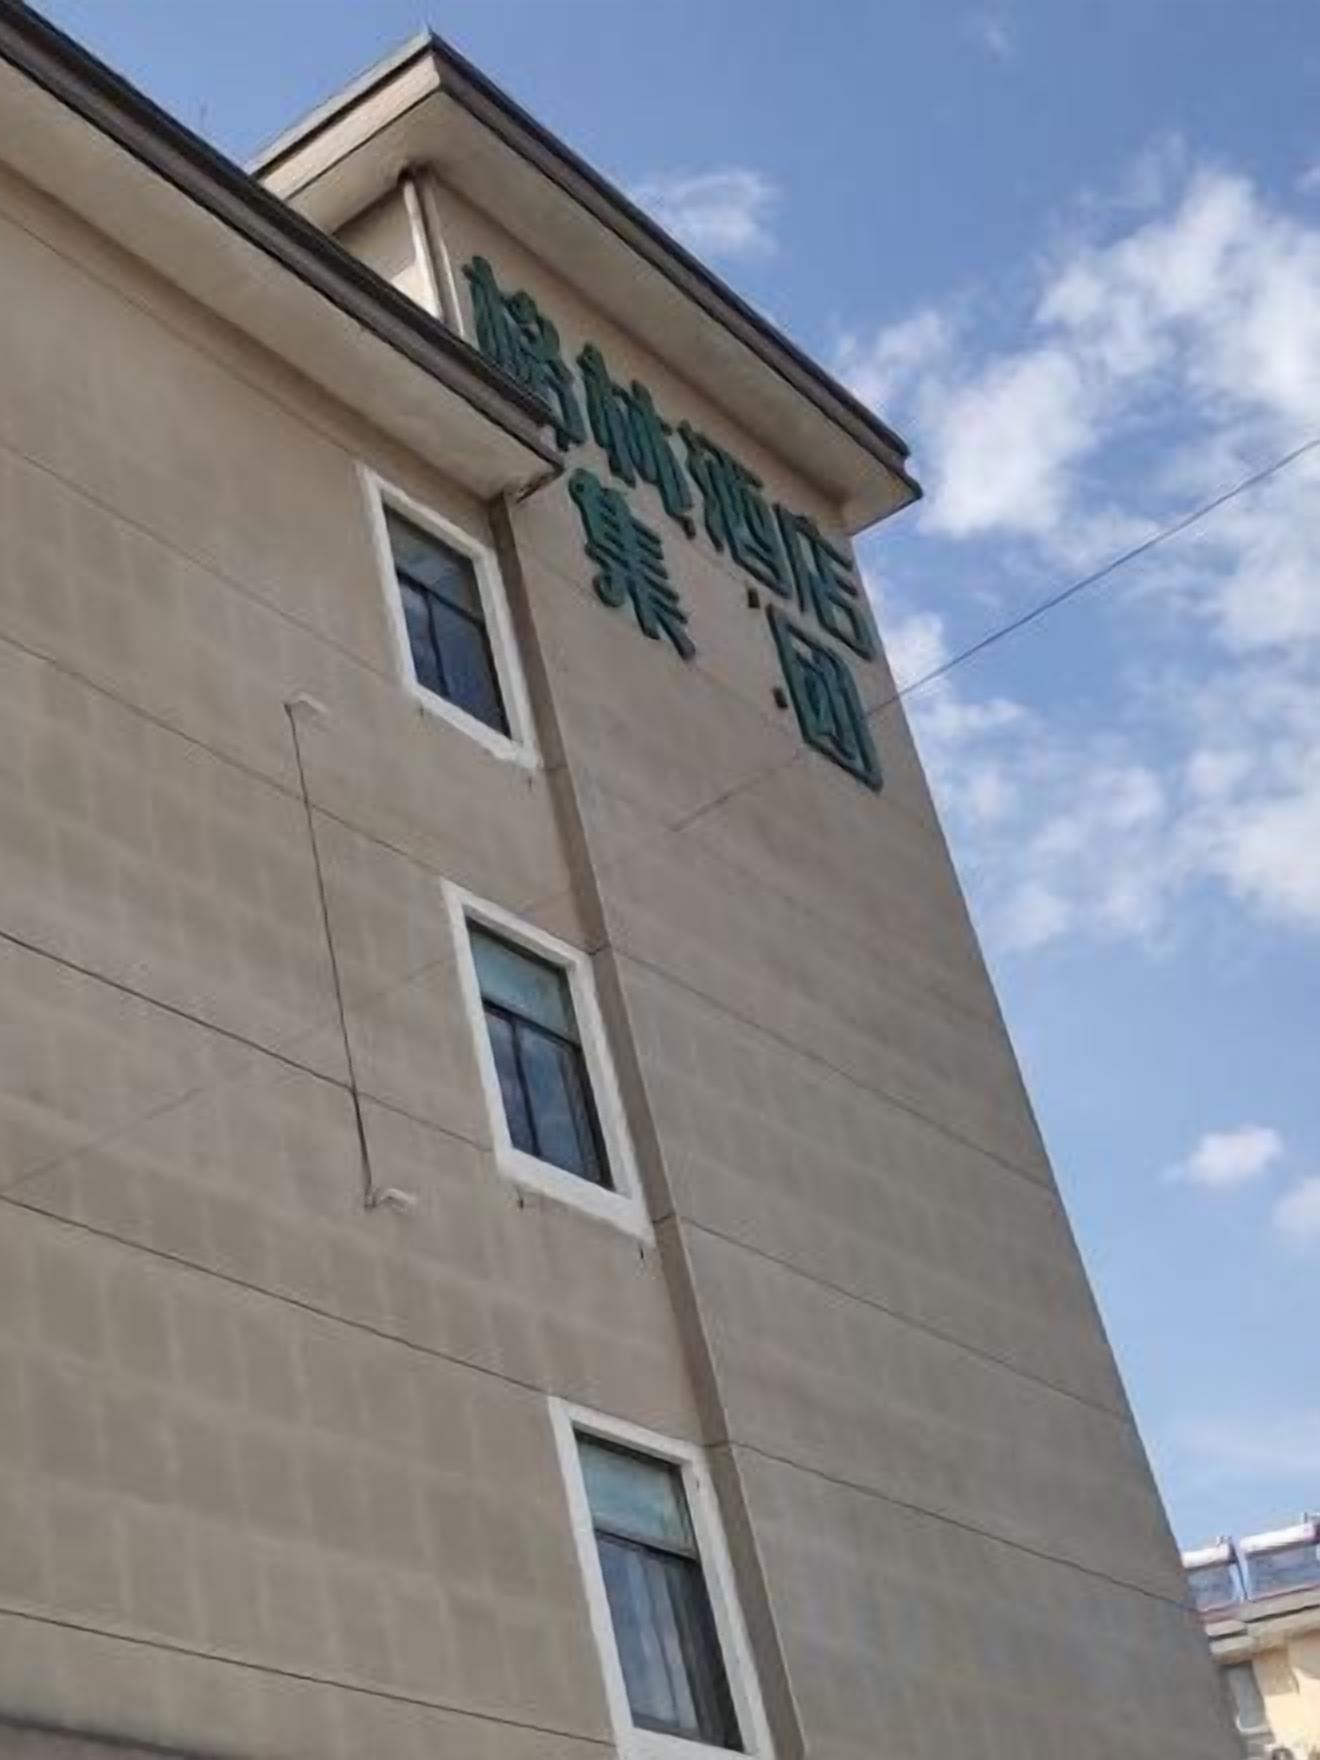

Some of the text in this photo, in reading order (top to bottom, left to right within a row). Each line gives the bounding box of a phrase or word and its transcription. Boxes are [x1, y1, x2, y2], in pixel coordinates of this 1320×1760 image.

[462, 255, 874, 661] 格林酒店
[568, 468, 883, 792] 集团
